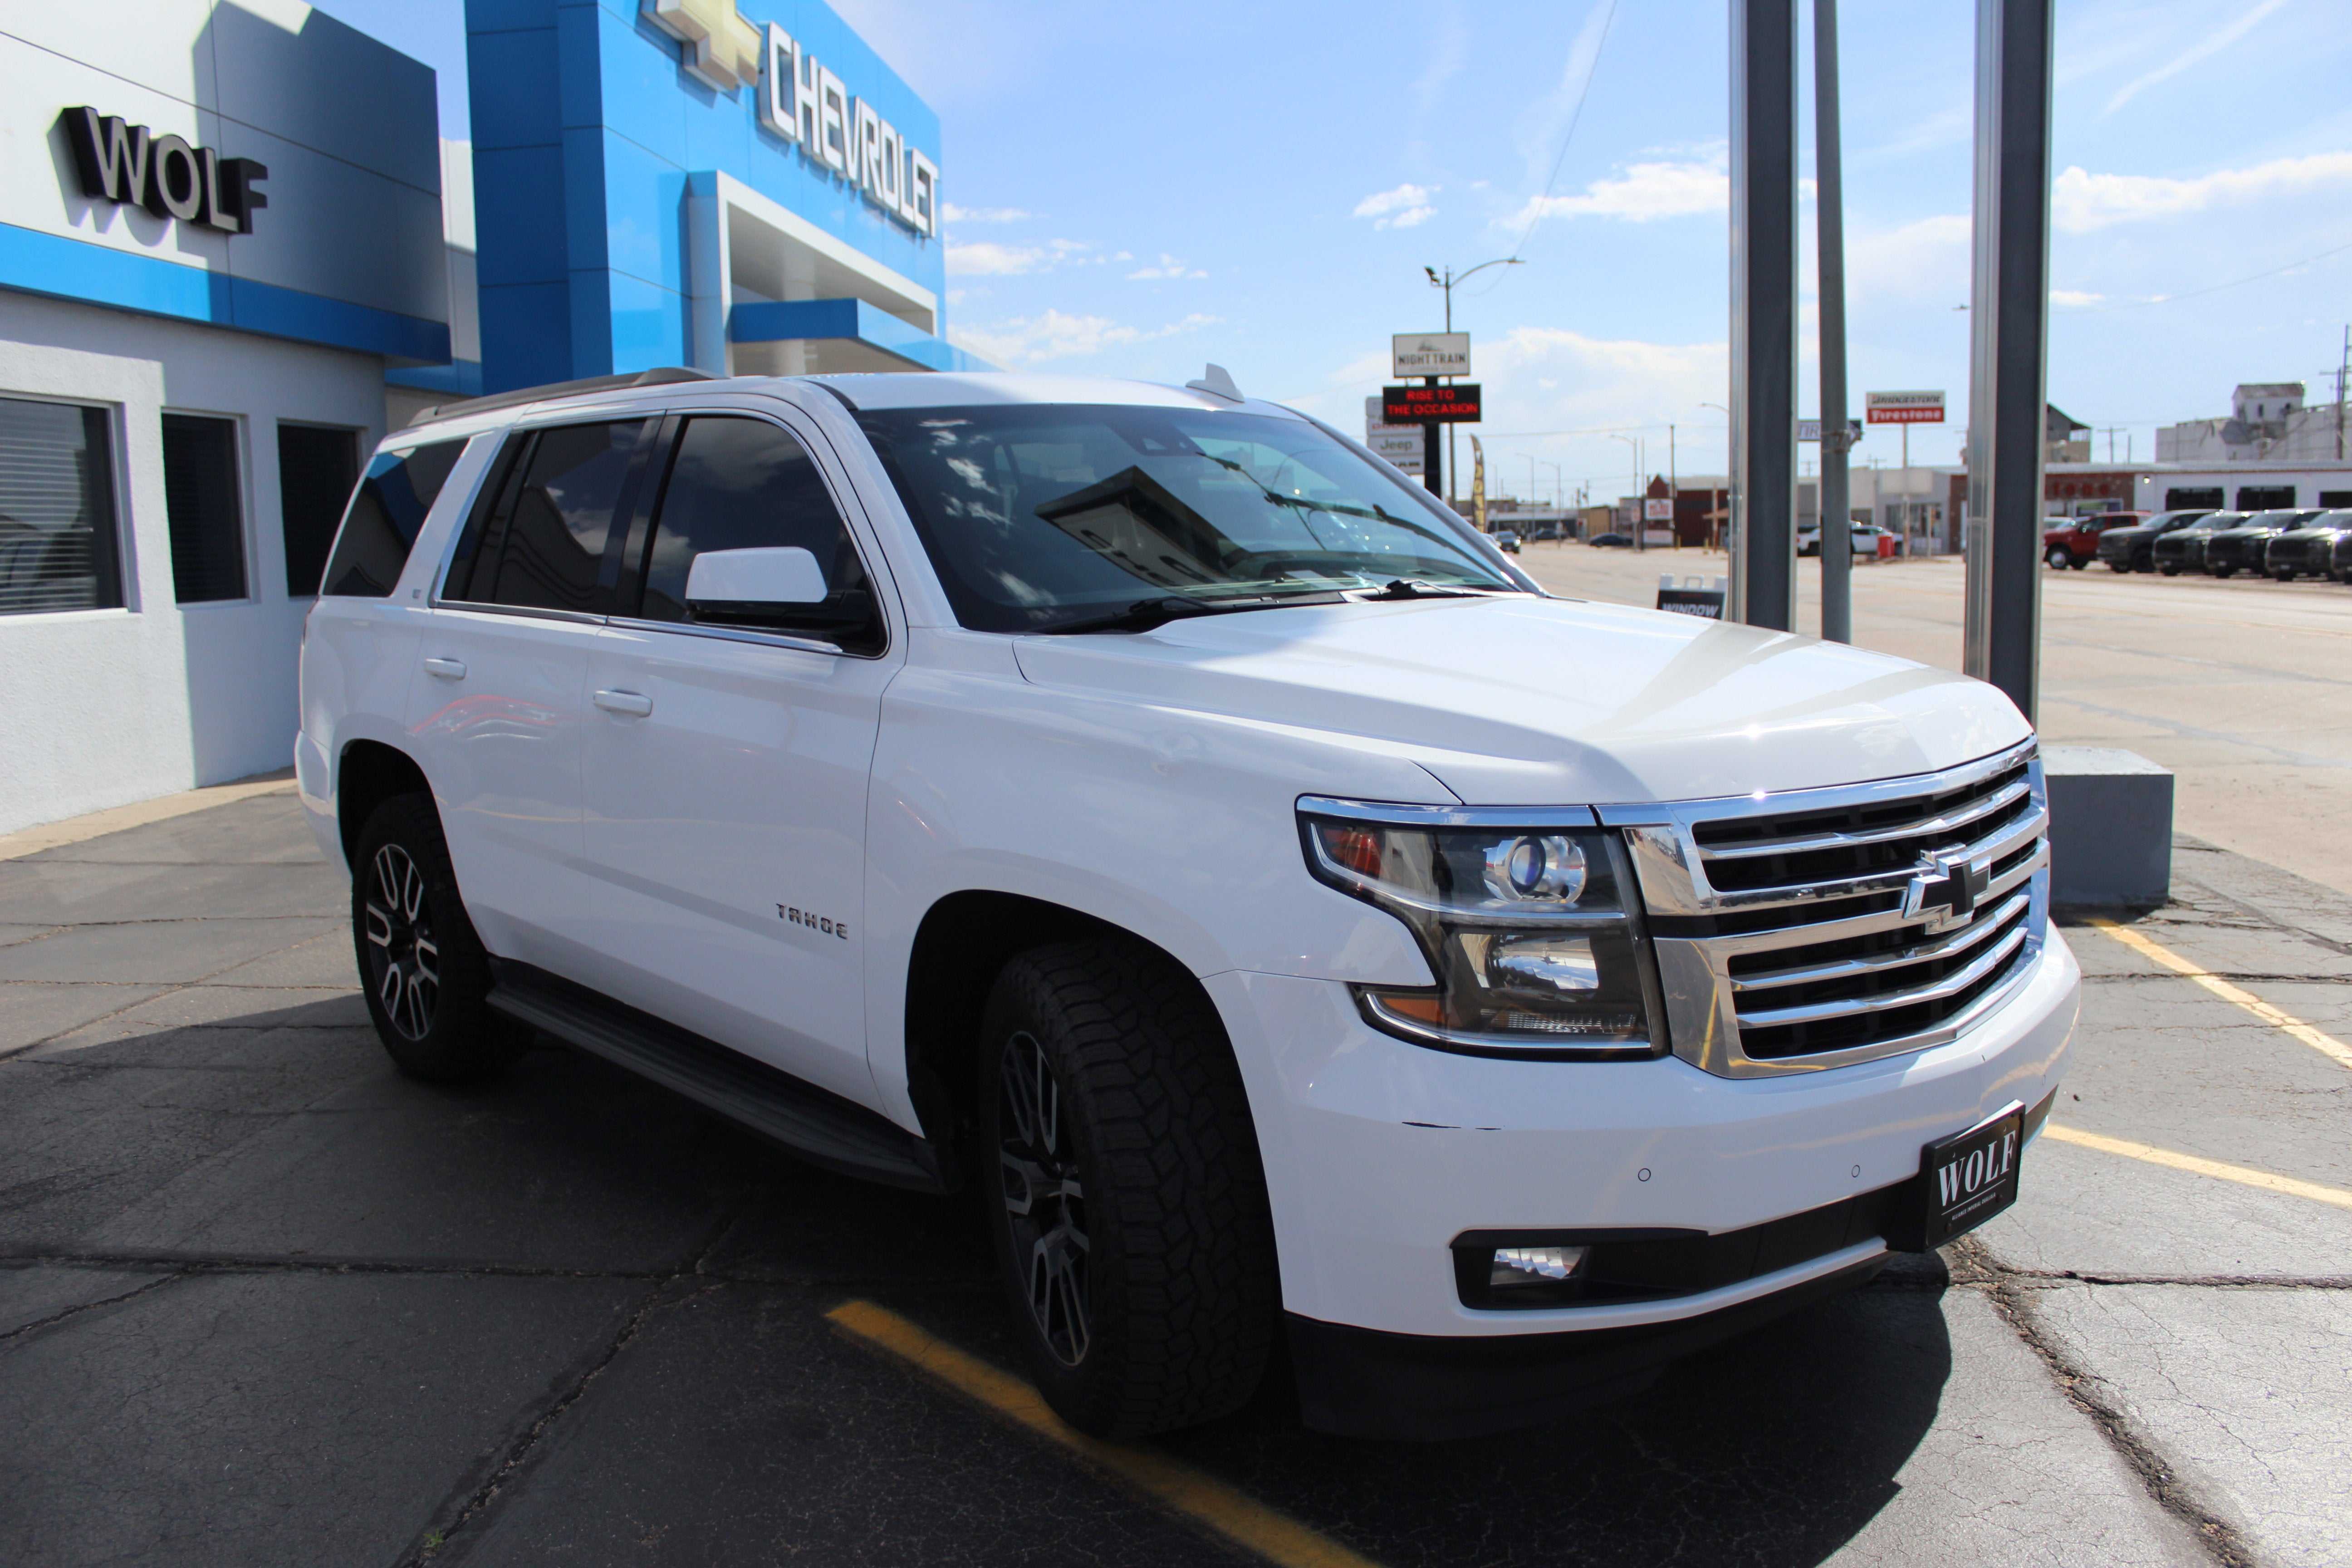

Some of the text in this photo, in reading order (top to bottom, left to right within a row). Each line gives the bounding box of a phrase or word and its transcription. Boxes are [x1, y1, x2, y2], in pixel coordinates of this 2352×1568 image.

[766, 21, 940, 238] CHEVROLET
[63, 106, 268, 235] WOLF
[1398, 352, 1466, 365] NIGHT TRAIN
[1406, 389, 1455, 401] RISE TO
[1872, 394, 1941, 404] BRIDGESTONE
[1387, 403, 1478, 416] THE OCCASION
[1871, 409, 1941, 422] Firestone
[1380, 439, 1413, 451] Jeep
[1662, 602, 1719, 618] WINDOW
[775, 902, 848, 940] TAHOE
[1938, 1130, 2017, 1207] WOLF
